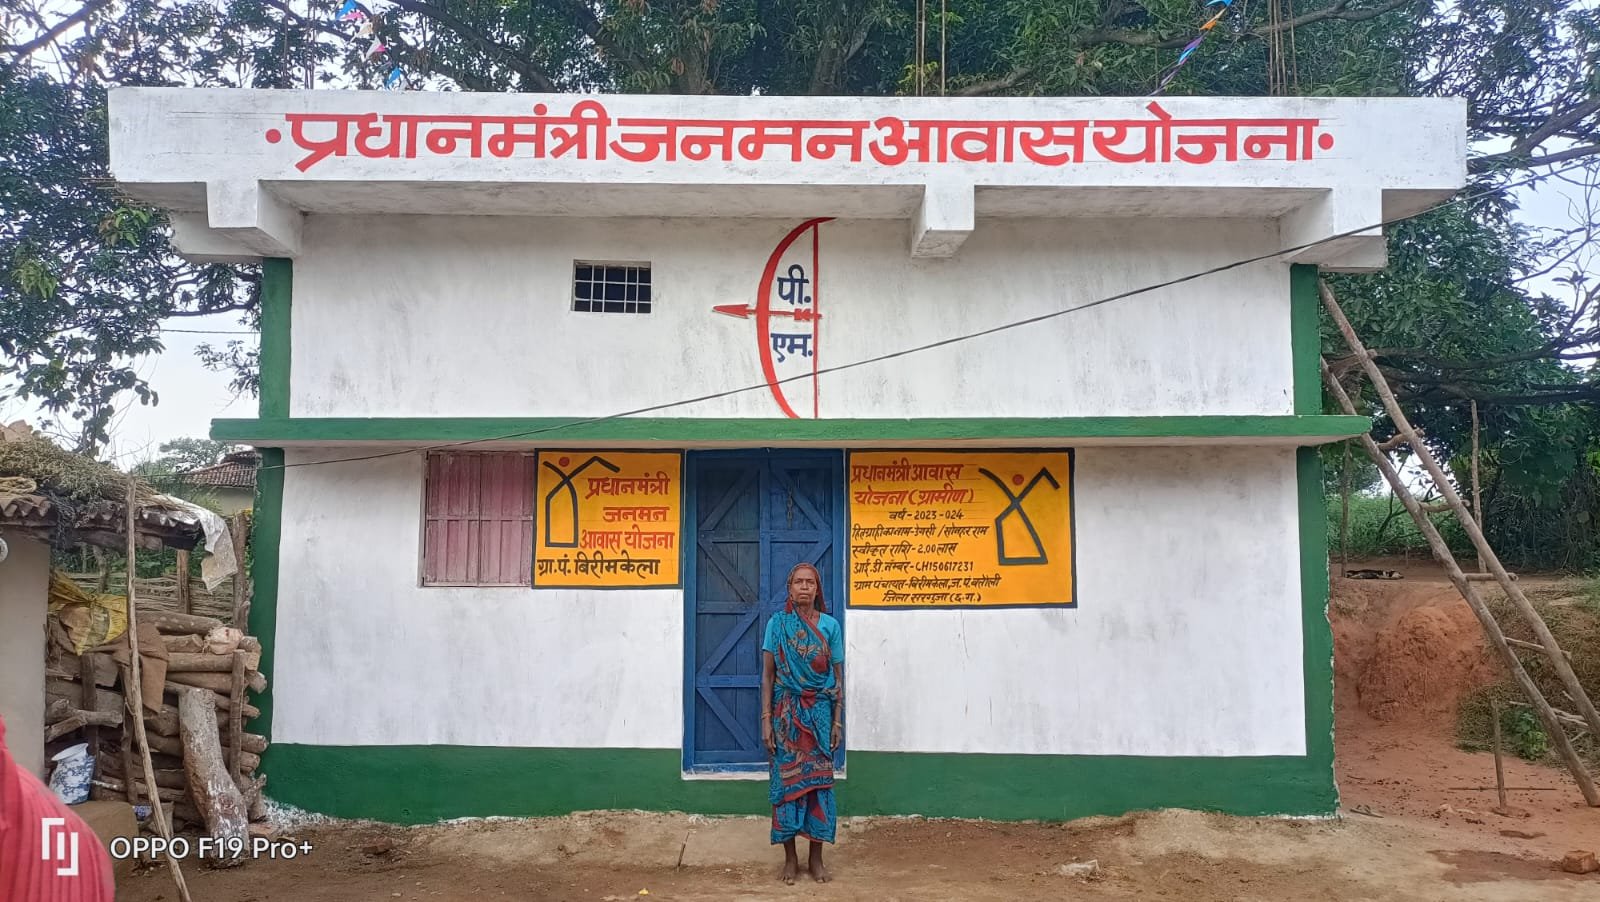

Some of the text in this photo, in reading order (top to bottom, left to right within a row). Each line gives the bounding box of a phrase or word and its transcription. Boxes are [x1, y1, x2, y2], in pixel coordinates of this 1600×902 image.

[285, 99, 1320, 172] प्रधानमंत्री जनमन आवास योजना
[777, 264, 811, 305] पी.
[770, 332, 813, 363] एम.
[851, 457, 964, 484] प्रधानमंत्री आवास
[585, 471, 671, 500] प्रधानमंत्री
[854, 485, 909, 506] योजना
[603, 506, 670, 523] जनमन
[580, 524, 675, 554] आवास योजना
[852, 541, 890, 559] स्वीकृत
[854, 581, 873, 591] ग्राम
[882, 589, 911, 603] जिला
